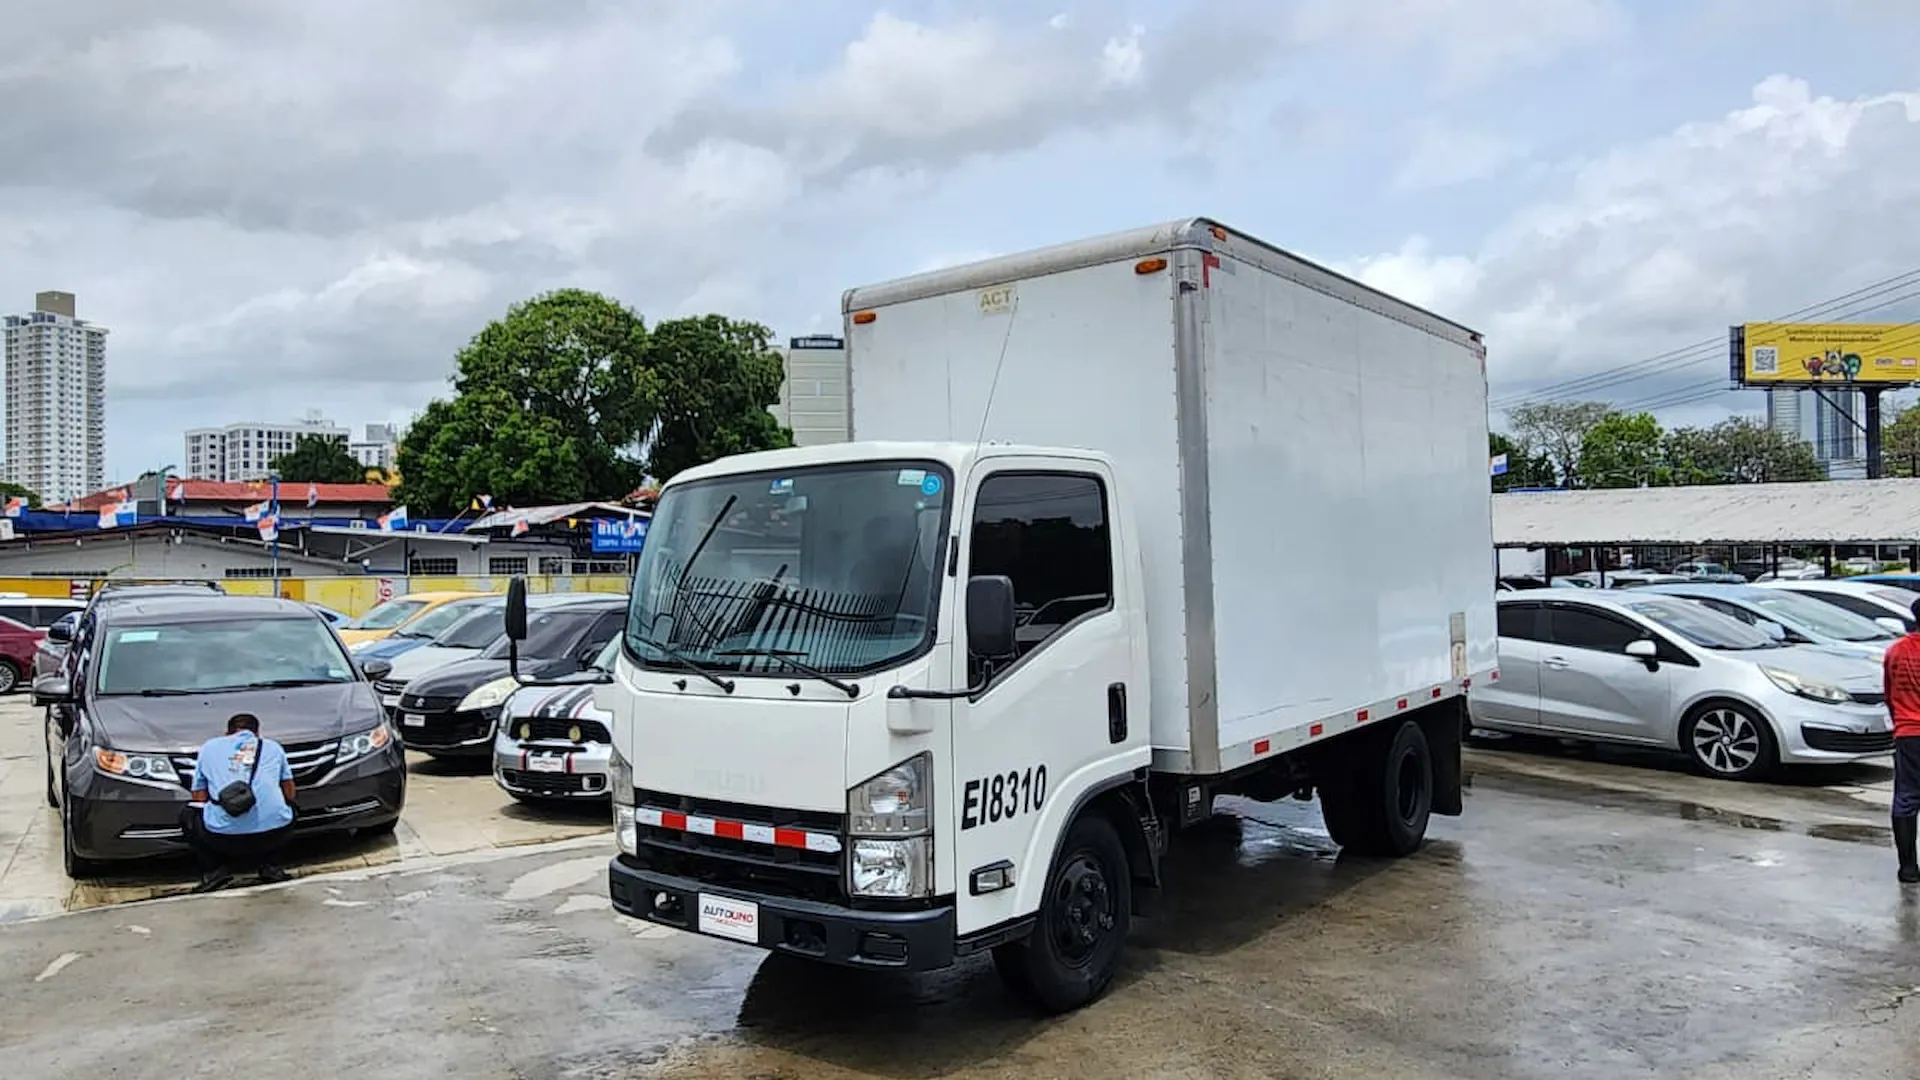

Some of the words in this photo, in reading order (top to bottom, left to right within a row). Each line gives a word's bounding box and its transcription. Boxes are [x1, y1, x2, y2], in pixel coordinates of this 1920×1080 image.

[980, 289, 1012, 307] ACT
[961, 763, 1046, 831] EI8310
[703, 904, 754, 924] AUTOUNO
